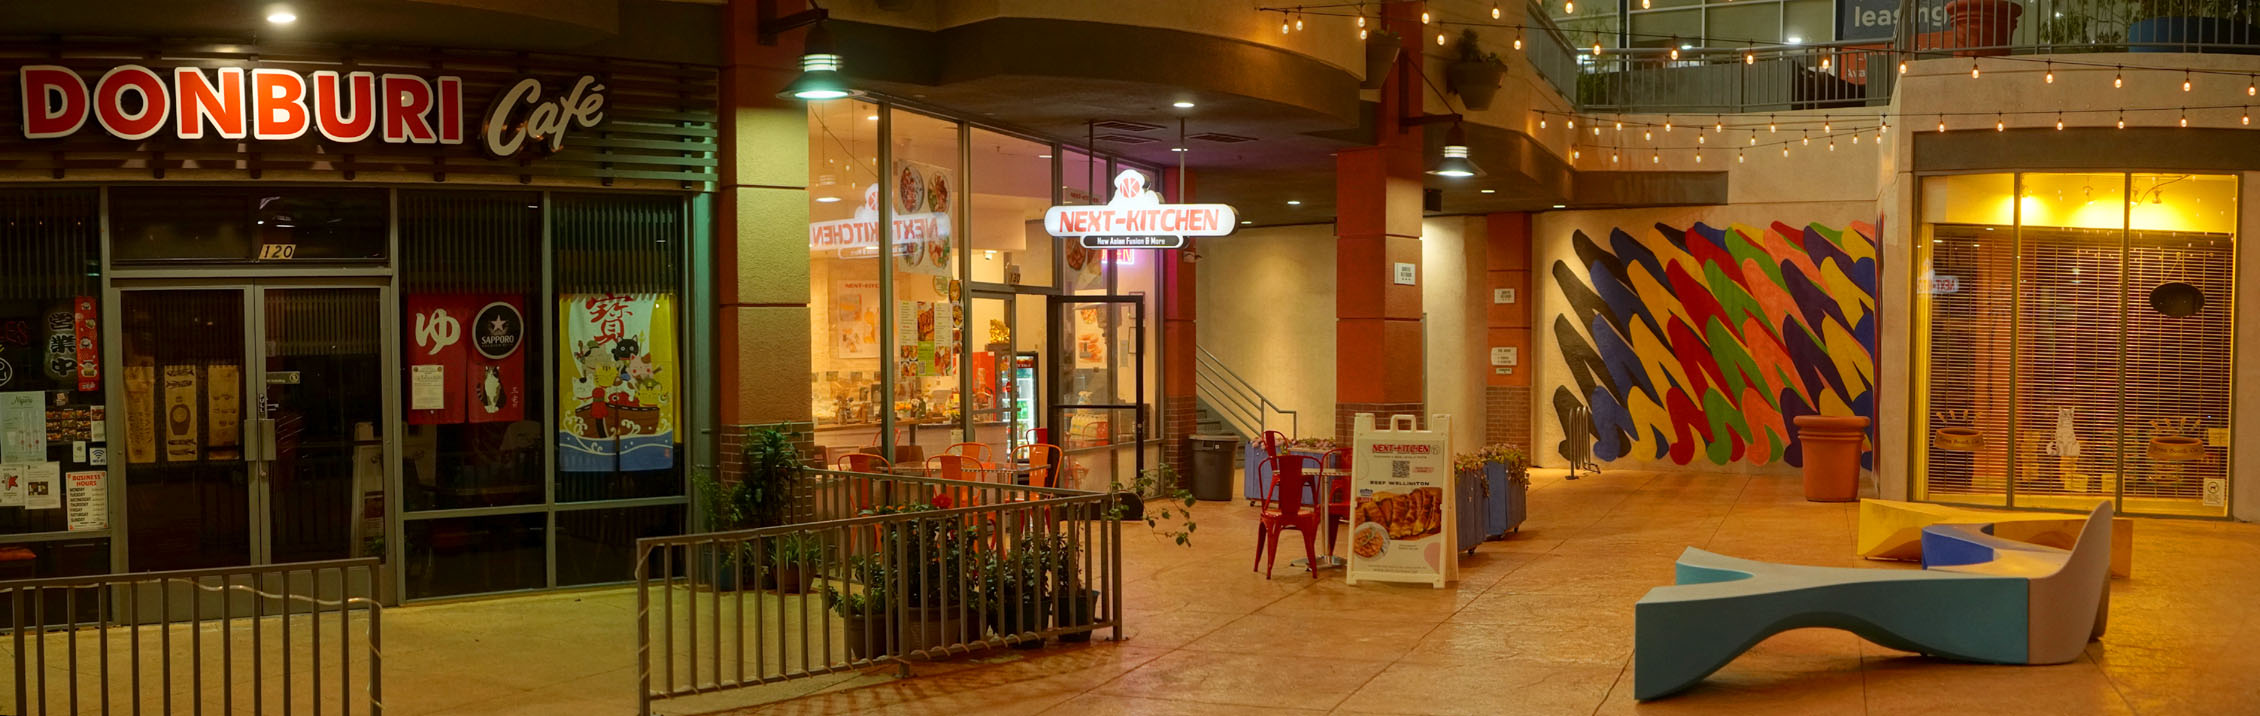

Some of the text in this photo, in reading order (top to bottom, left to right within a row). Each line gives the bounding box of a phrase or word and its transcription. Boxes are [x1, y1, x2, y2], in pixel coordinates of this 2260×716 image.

[20, 63, 605, 157] DONBURI Café
[1059, 208, 1220, 233] NEXT-KITCHEN
[1097, 237, 1109, 245] New
[1110, 237, 1126, 245] Asian
[1126, 237, 1144, 245] Fusion
[1151, 237, 1165, 245] More
[264, 245, 293, 258] 120
[415, 308, 461, 355] ゆ
[481, 335, 515, 345] SAPPORO
